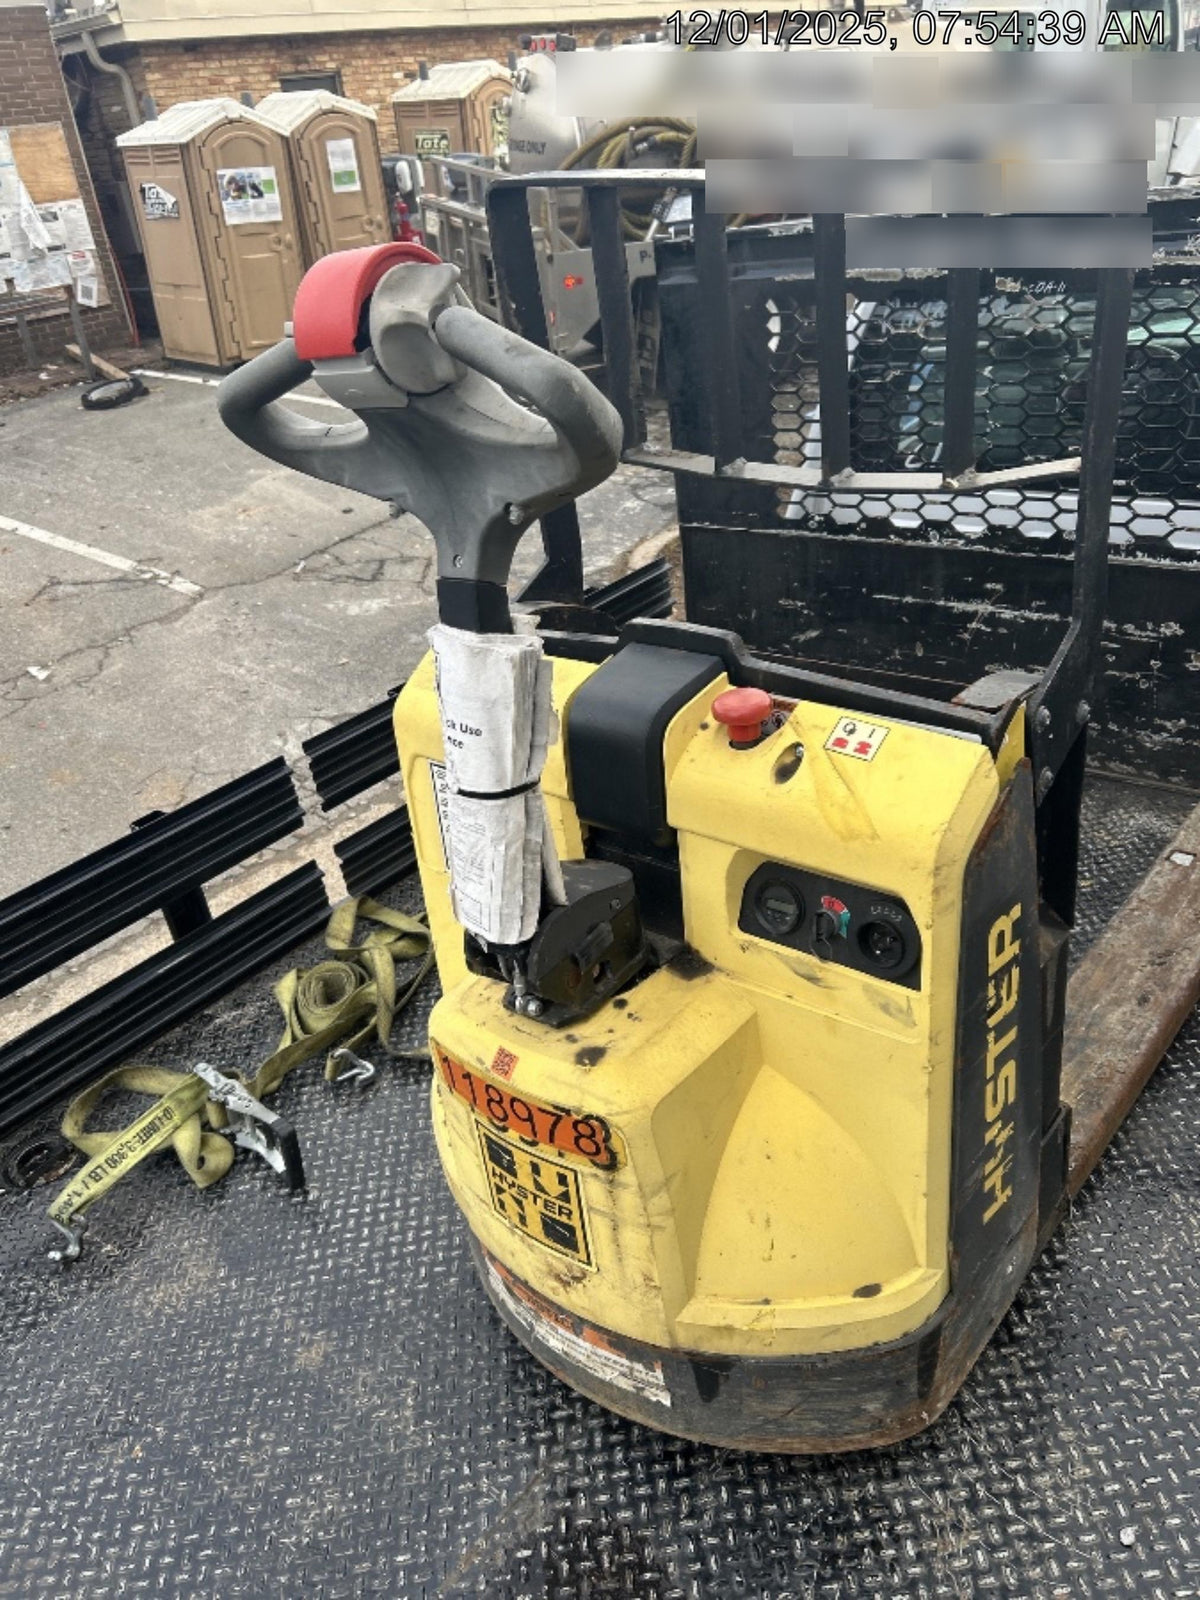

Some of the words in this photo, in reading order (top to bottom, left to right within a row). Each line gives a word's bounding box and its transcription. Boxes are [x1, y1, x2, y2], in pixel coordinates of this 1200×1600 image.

[416, 133, 449, 149] Tate
[459, 722, 483, 737] Use
[442, 1055, 602, 1157] 118978
[88, 1164, 109, 1185] LB
[491, 1169, 574, 1221] HYSTER
